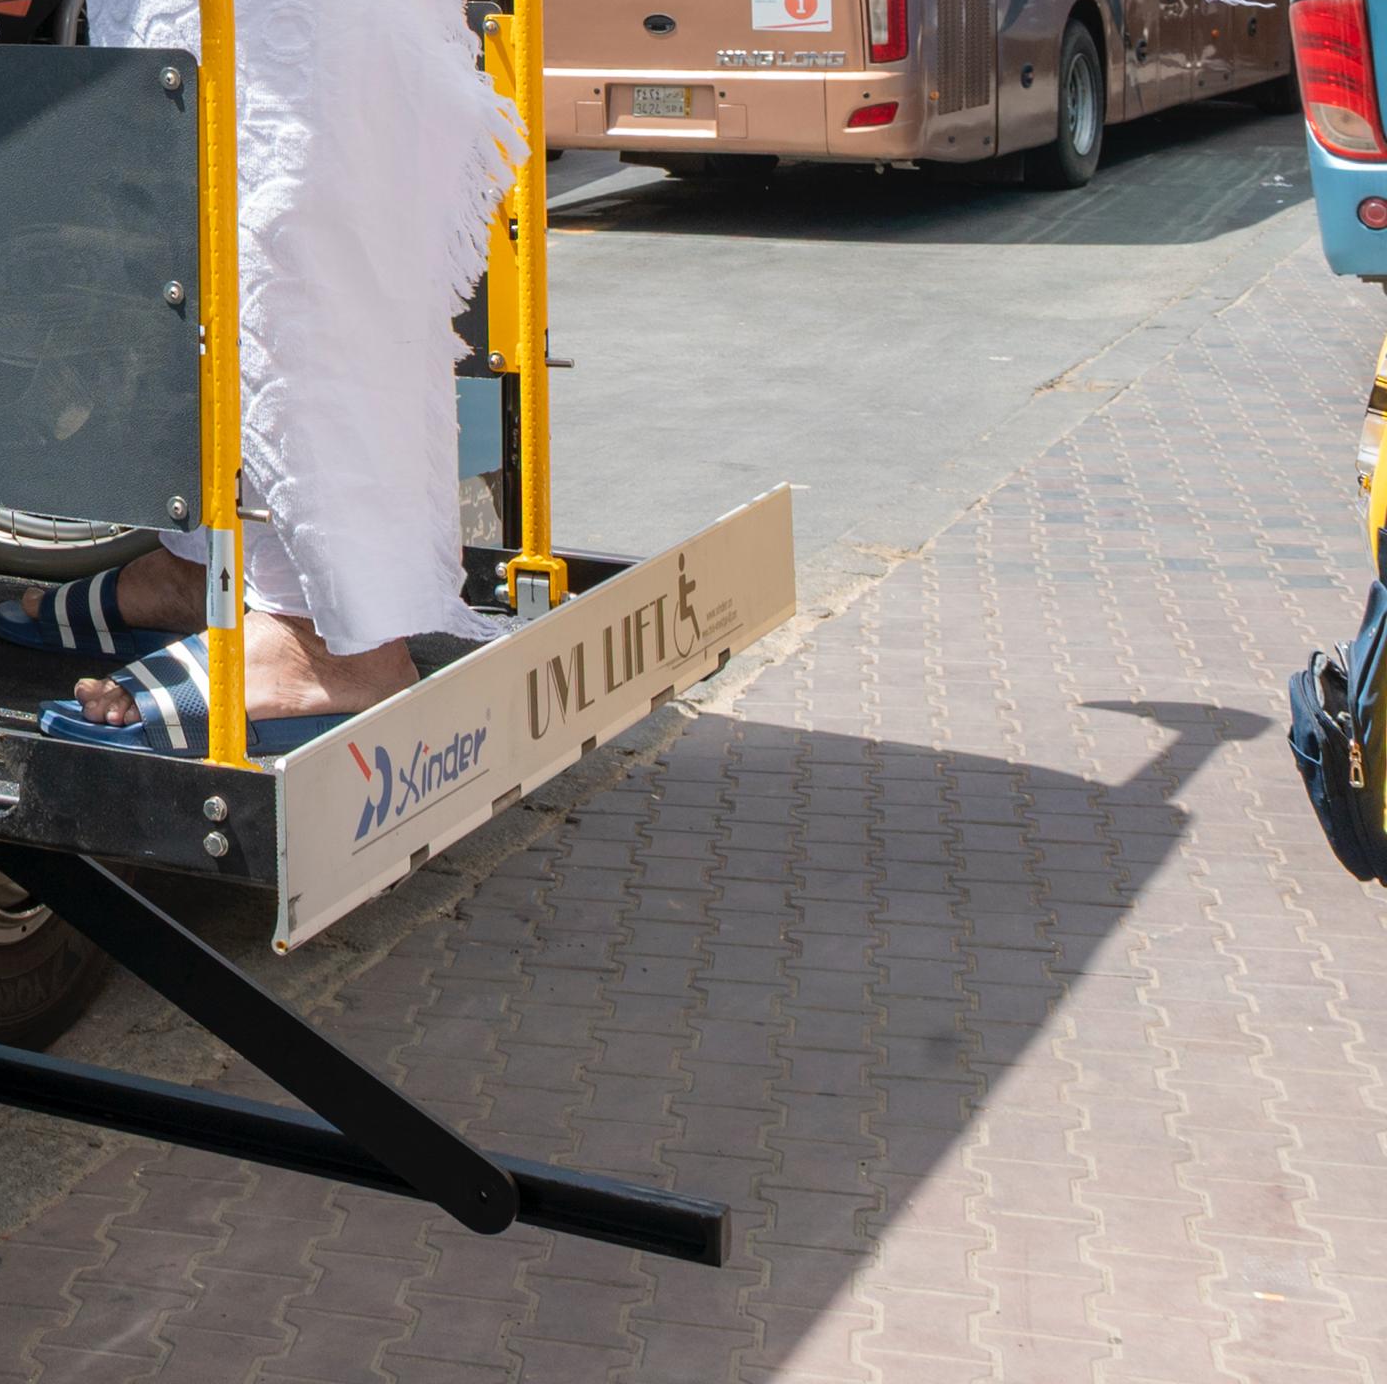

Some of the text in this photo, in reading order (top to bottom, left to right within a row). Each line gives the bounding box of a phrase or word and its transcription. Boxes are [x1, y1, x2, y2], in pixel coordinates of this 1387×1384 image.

[715, 49, 846, 67] KING LONG
[525, 593, 668, 740] UVL LIFT
